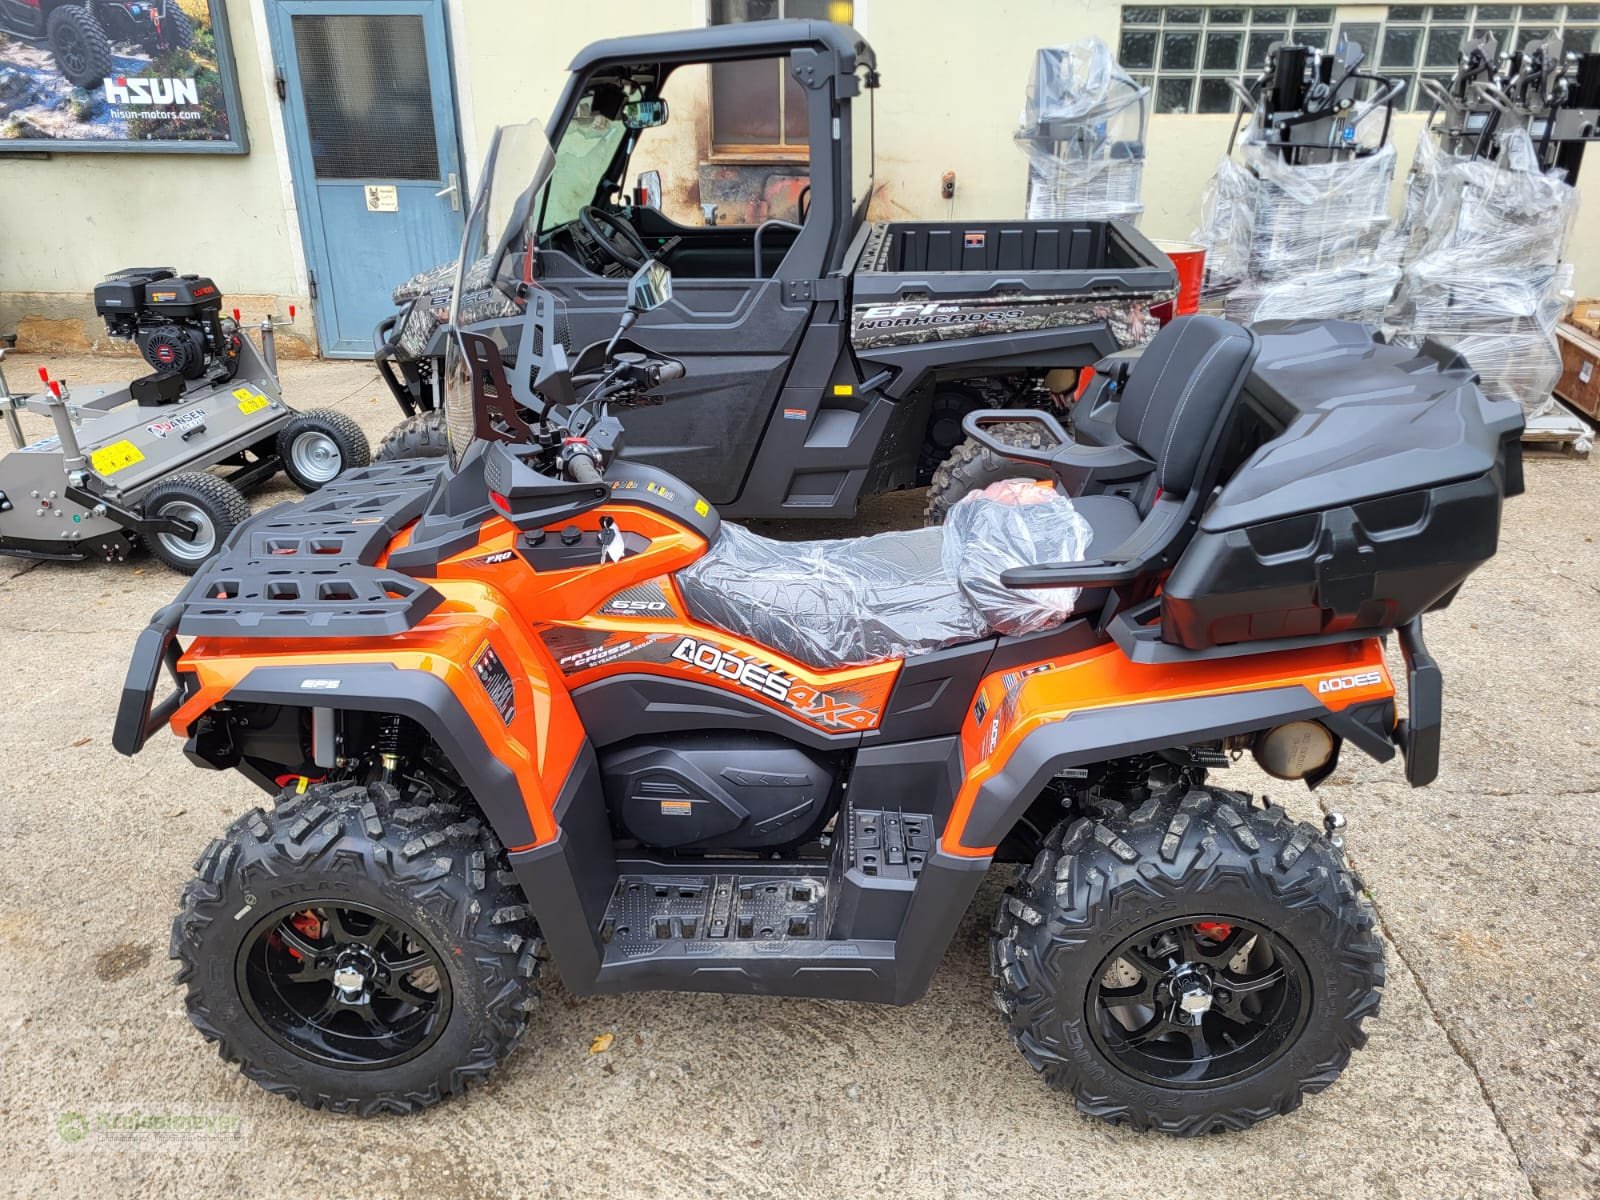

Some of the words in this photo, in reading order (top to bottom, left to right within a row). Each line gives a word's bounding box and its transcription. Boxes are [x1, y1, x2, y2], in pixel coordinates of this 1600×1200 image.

[110, 109, 201, 120] hisun-motors.com
[484, 551, 513, 564] PRO
[611, 600, 667, 610] 650
[574, 641, 632, 667] CROSS
[671, 637, 793, 702] AODES
[1318, 671, 1382, 694] AODES
[270, 881, 351, 900] ATLAS
[1101, 899, 1178, 944] ATLAS
